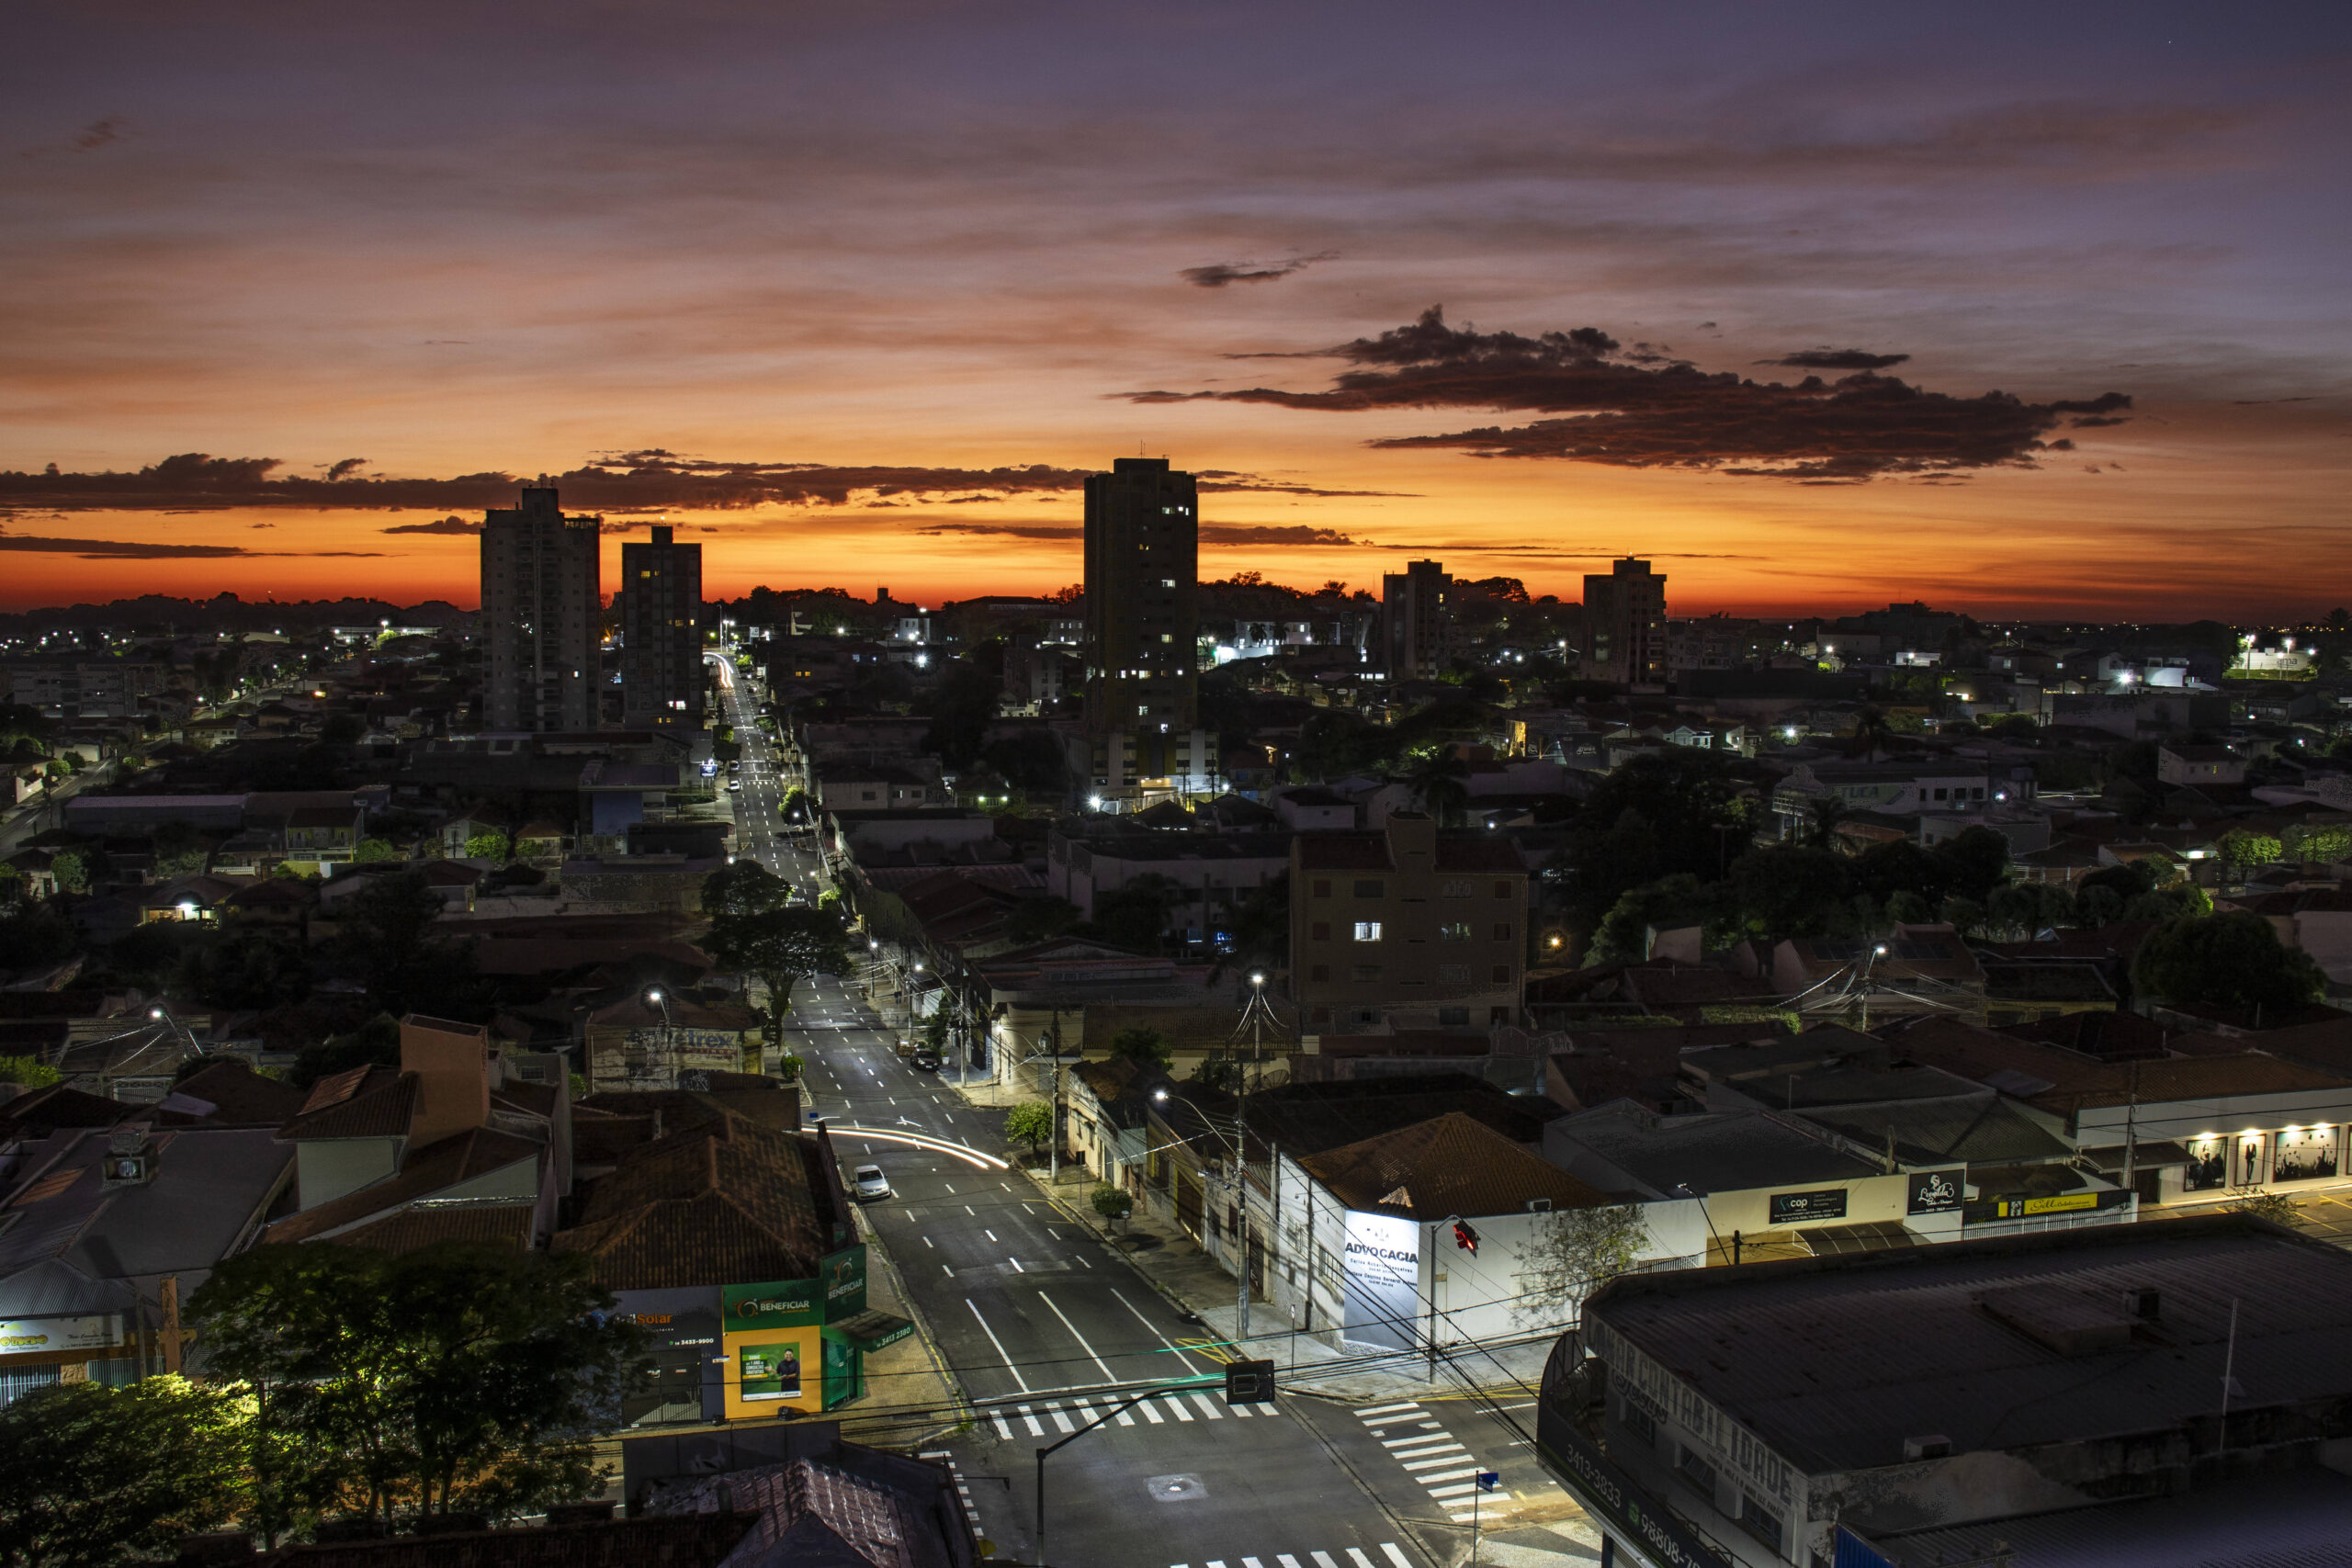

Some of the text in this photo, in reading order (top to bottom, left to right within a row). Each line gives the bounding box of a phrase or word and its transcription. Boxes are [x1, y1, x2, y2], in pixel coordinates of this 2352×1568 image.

[1791, 1198, 1808, 1209] cop
[1345, 1242, 1419, 1264] ADVOCACIA
[829, 1279, 863, 1300] BENEFICIAR
[760, 1301, 809, 1312] BENEFICIAR
[882, 1334, 896, 1347] 3413
[896, 1326, 911, 1340] 2380
[1638, 1354, 1792, 1507] CONTABILIDADE
[1566, 1444, 1703, 1568] 3413-3833 98808-7
